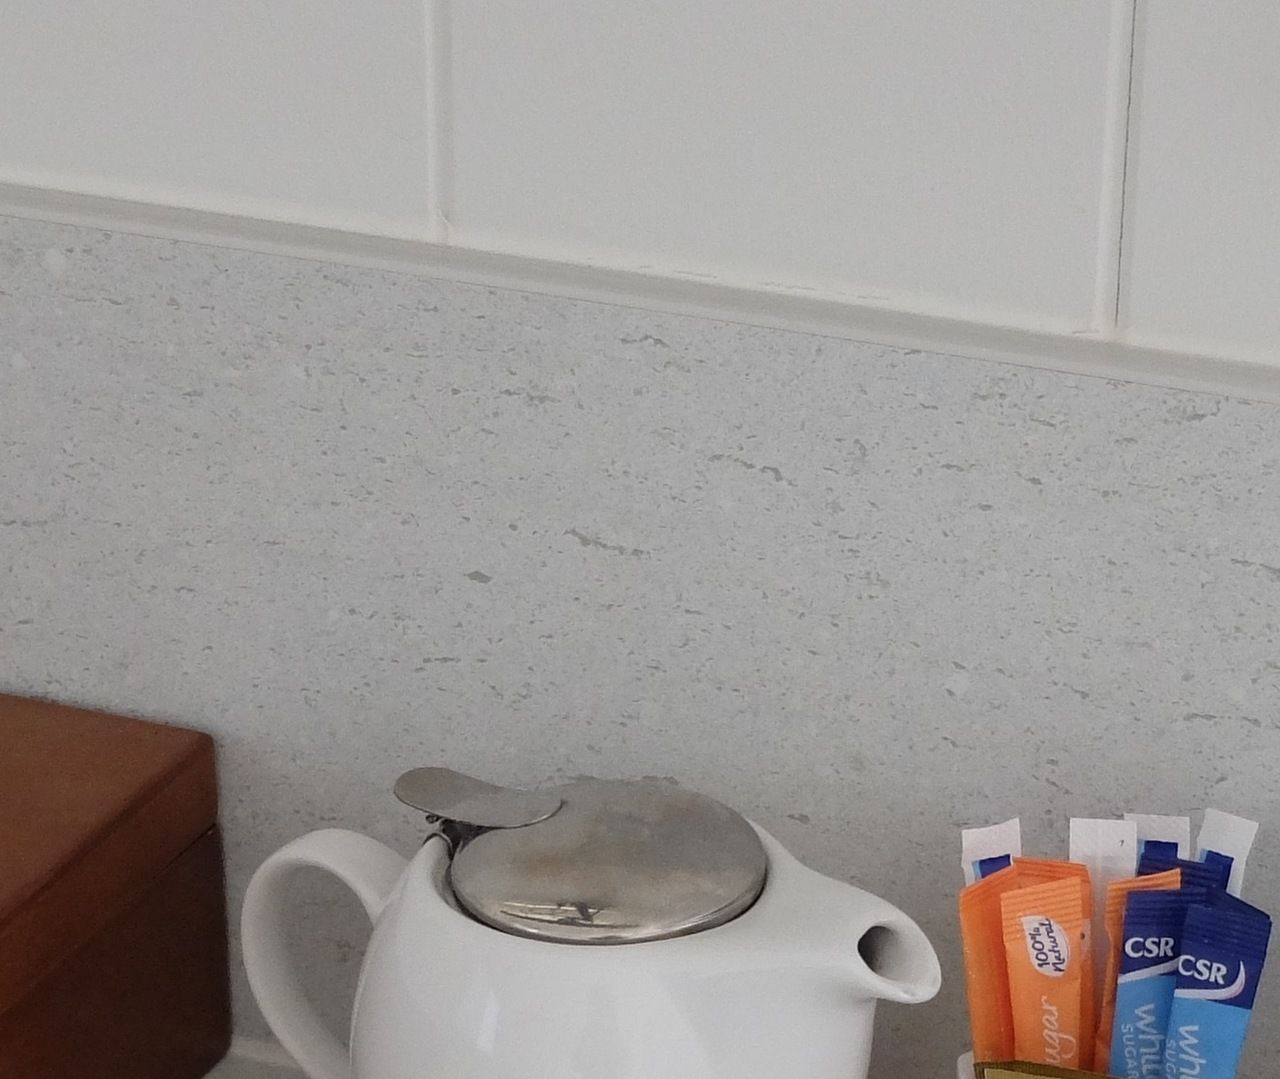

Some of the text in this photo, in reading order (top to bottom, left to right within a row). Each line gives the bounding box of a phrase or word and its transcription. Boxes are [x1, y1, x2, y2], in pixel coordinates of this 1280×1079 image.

[1031, 926, 1051, 969] 100%
[1124, 936, 1175, 959] CSR
[1177, 954, 1228, 985] CSR
[1040, 995, 1077, 1068] ugar
